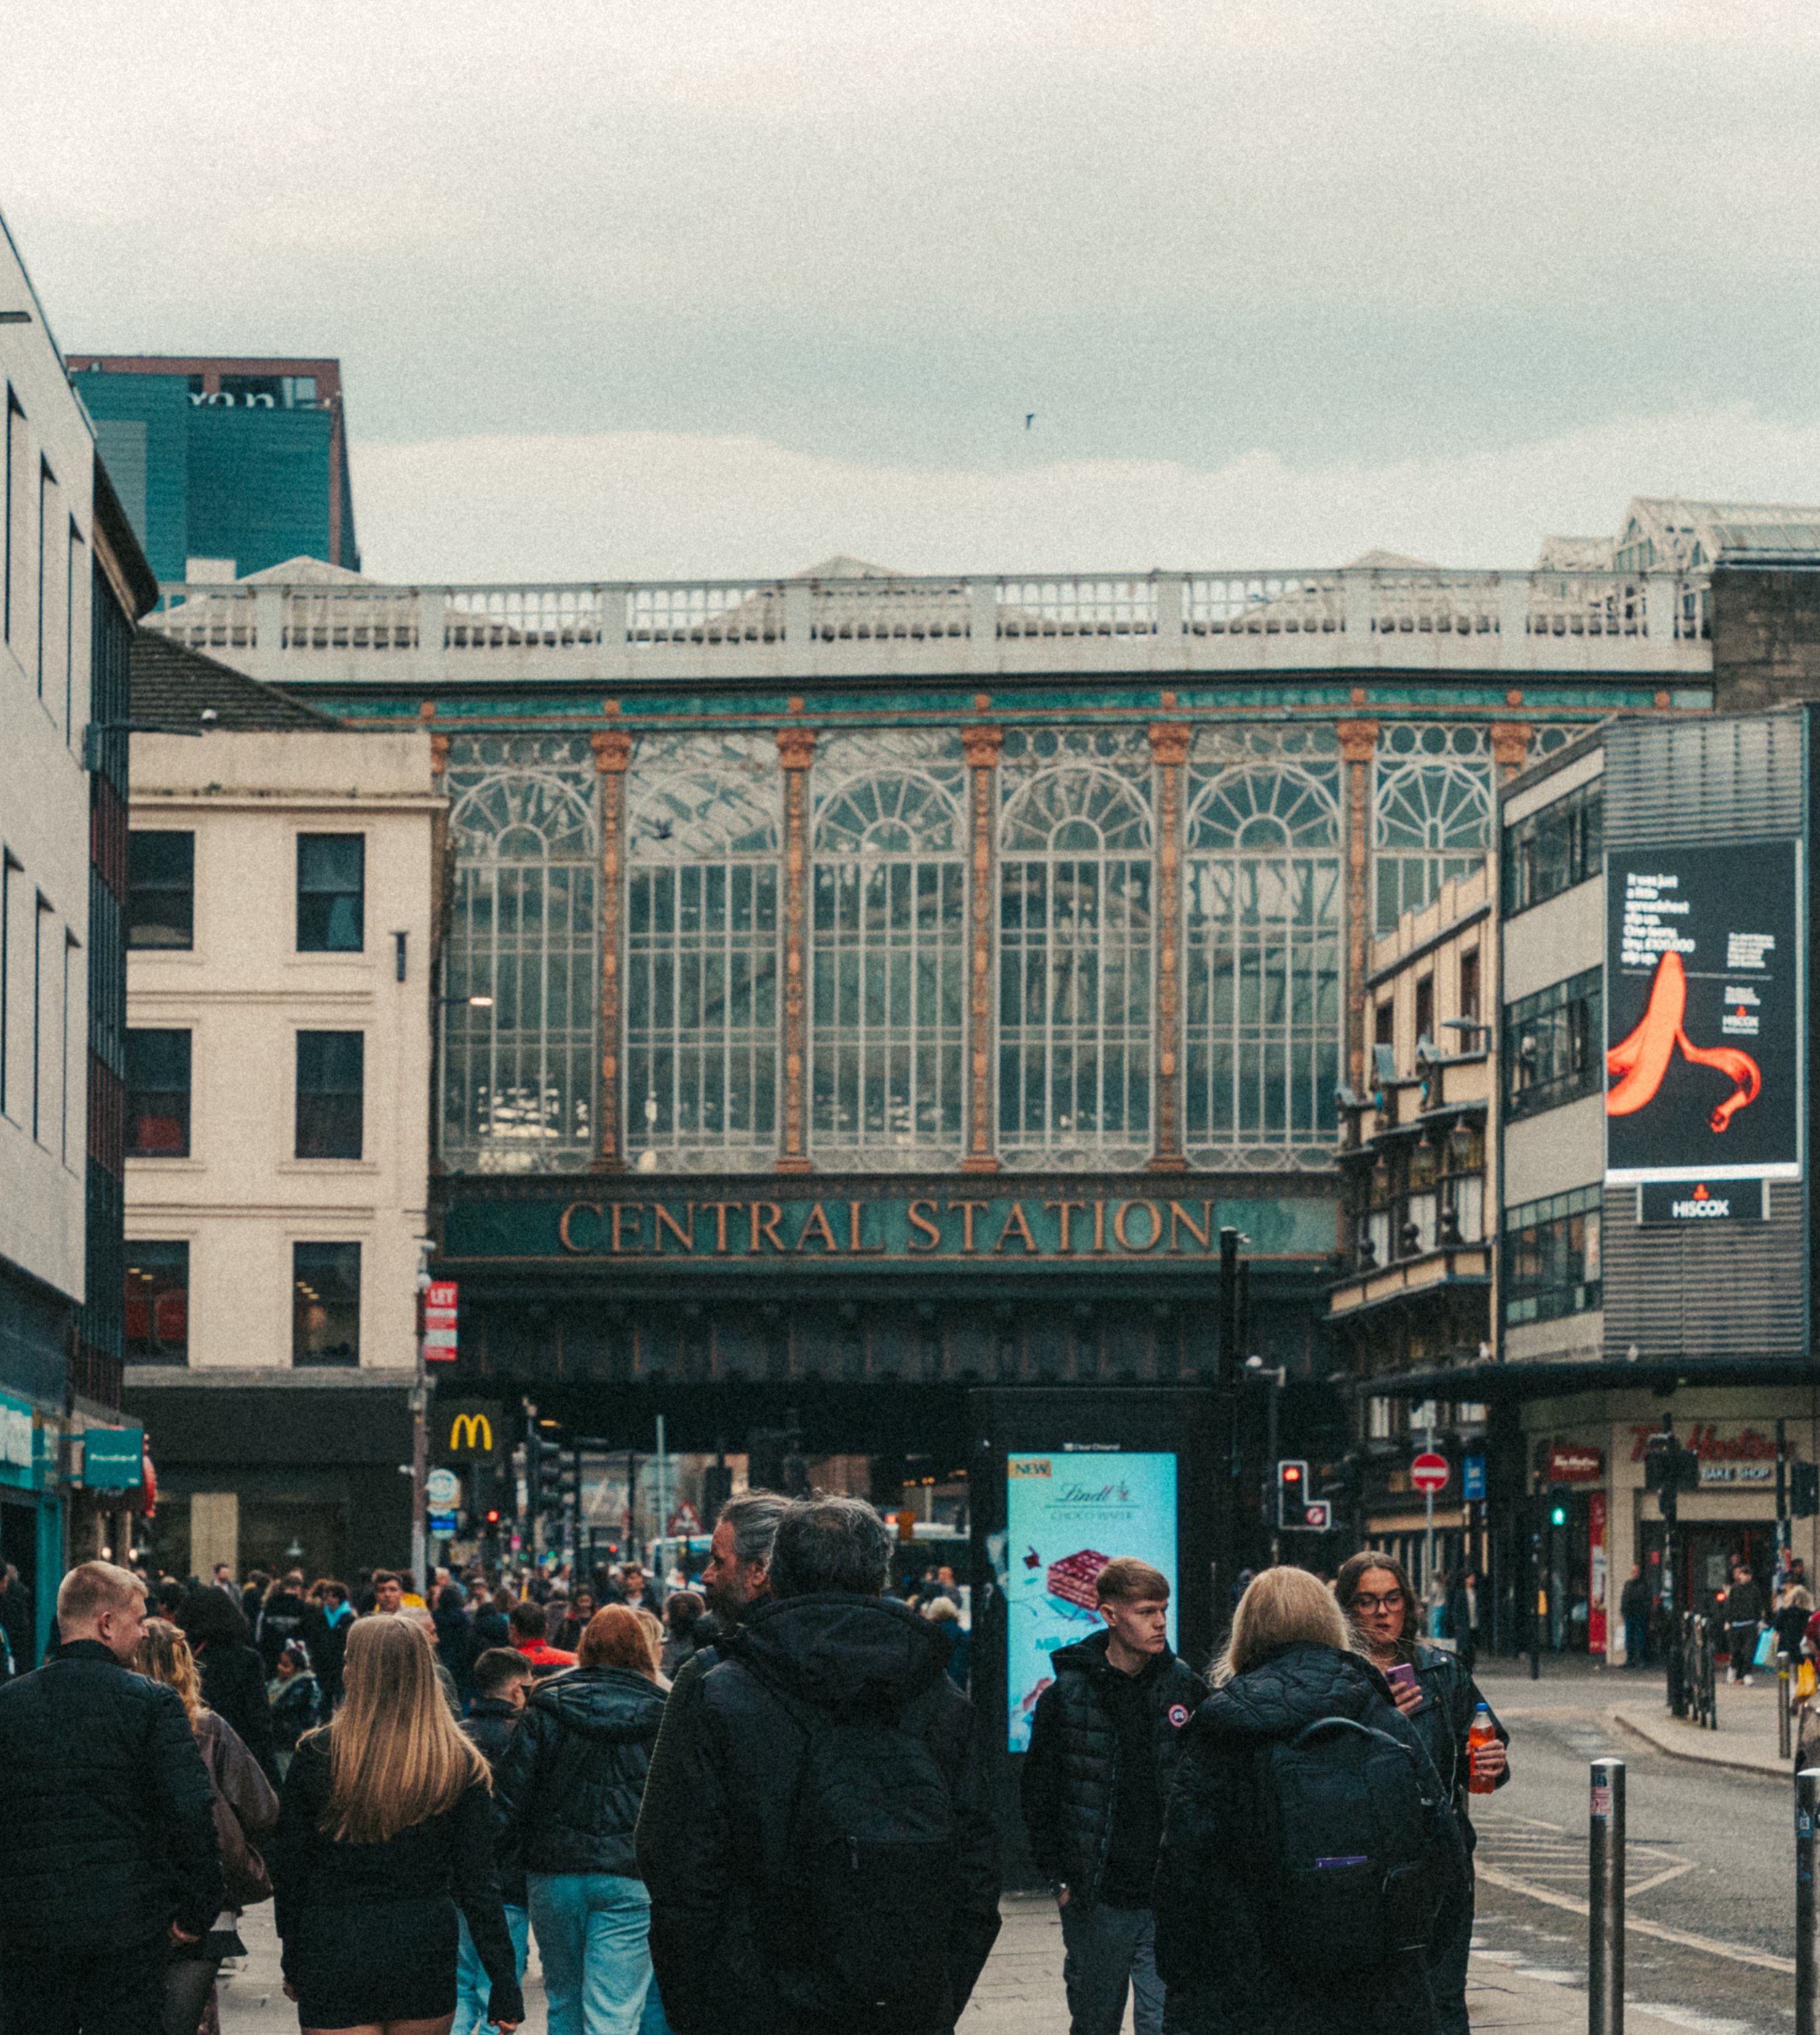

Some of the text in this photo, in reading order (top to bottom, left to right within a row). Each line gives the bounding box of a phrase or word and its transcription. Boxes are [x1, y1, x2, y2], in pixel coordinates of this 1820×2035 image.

[1672, 1199, 1729, 1218] HISCOX
[558, 1199, 1214, 1252] CENTRAL STATION
[431, 1287, 454, 1305] LET
[1016, 1463, 1048, 1475] NEW
[1054, 1482, 1114, 1502] Lindt
